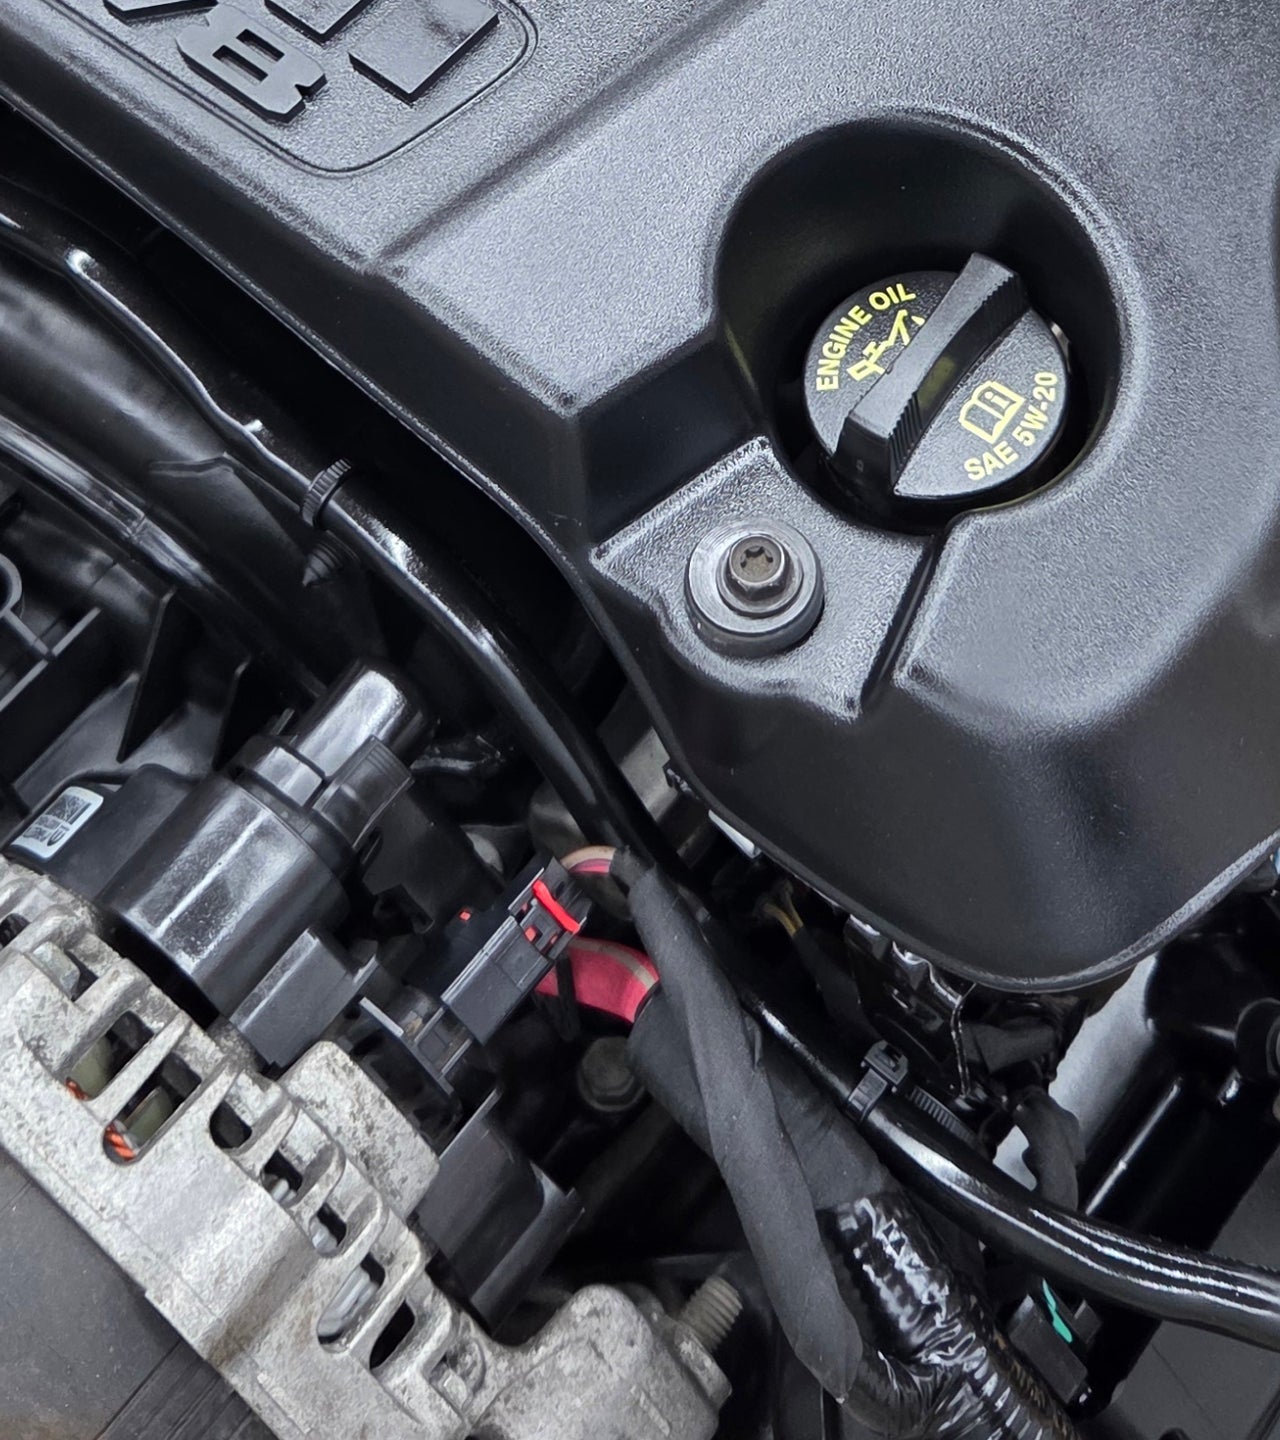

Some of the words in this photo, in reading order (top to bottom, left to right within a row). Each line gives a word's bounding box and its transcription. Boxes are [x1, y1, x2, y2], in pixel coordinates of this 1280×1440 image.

[816, 305, 873, 391] ENGINE
[868, 283, 916, 311] OIL
[964, 441, 1020, 481] SAE
[1012, 372, 1058, 446] 5W-20
